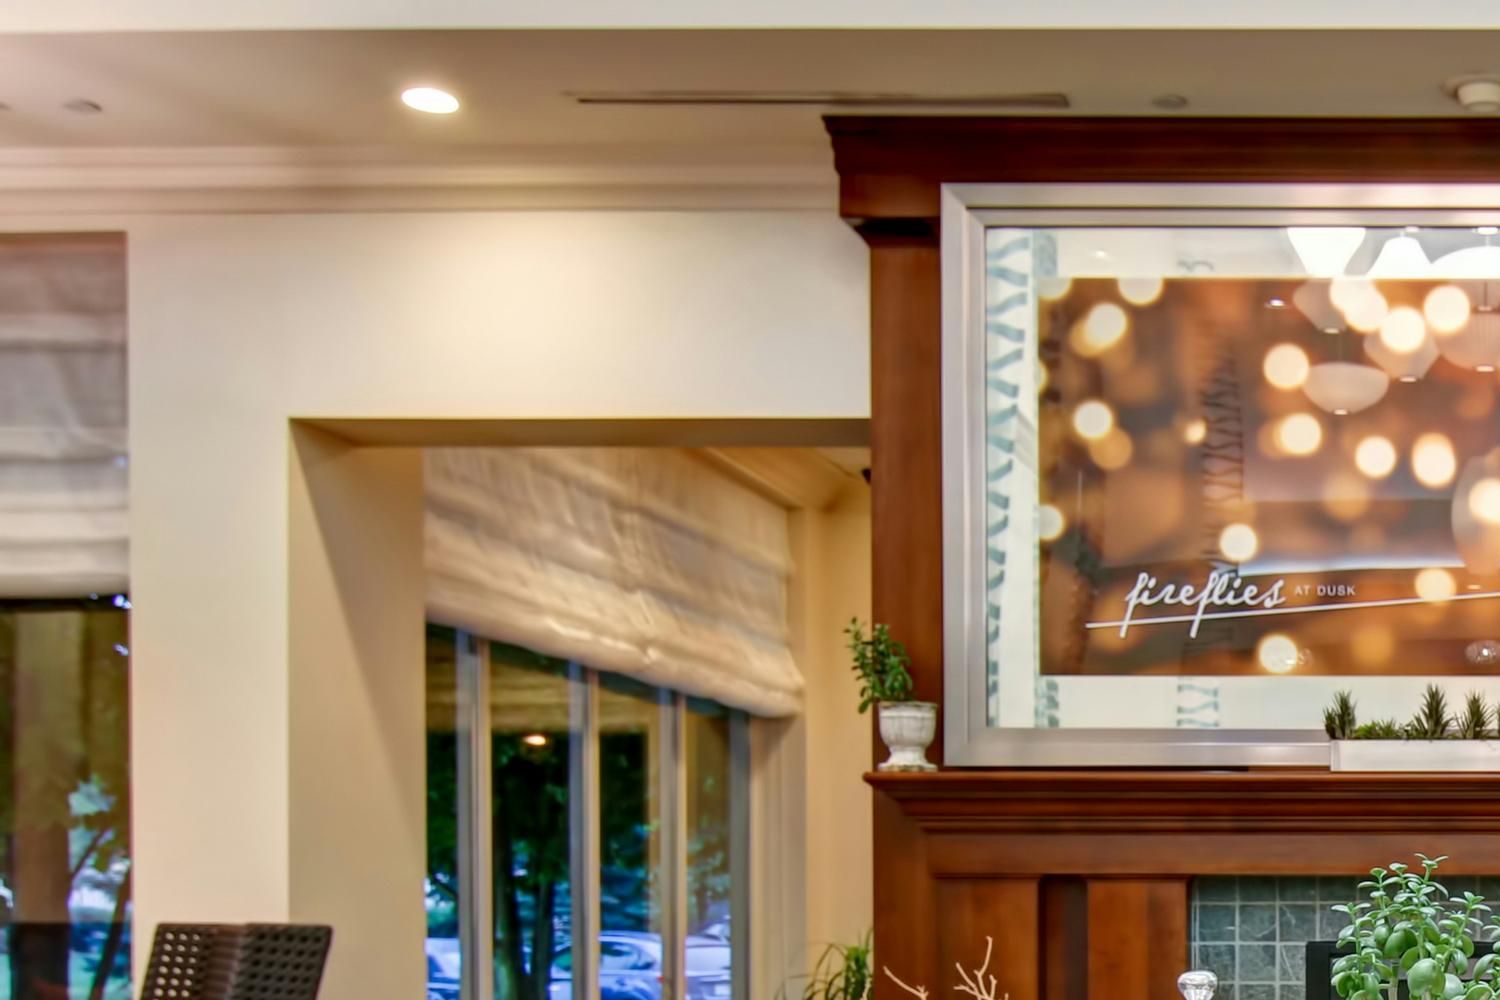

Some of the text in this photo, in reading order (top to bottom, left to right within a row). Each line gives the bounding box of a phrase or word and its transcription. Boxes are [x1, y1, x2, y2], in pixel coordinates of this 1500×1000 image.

[1119, 571, 1357, 638] fireflies AT DUSK
